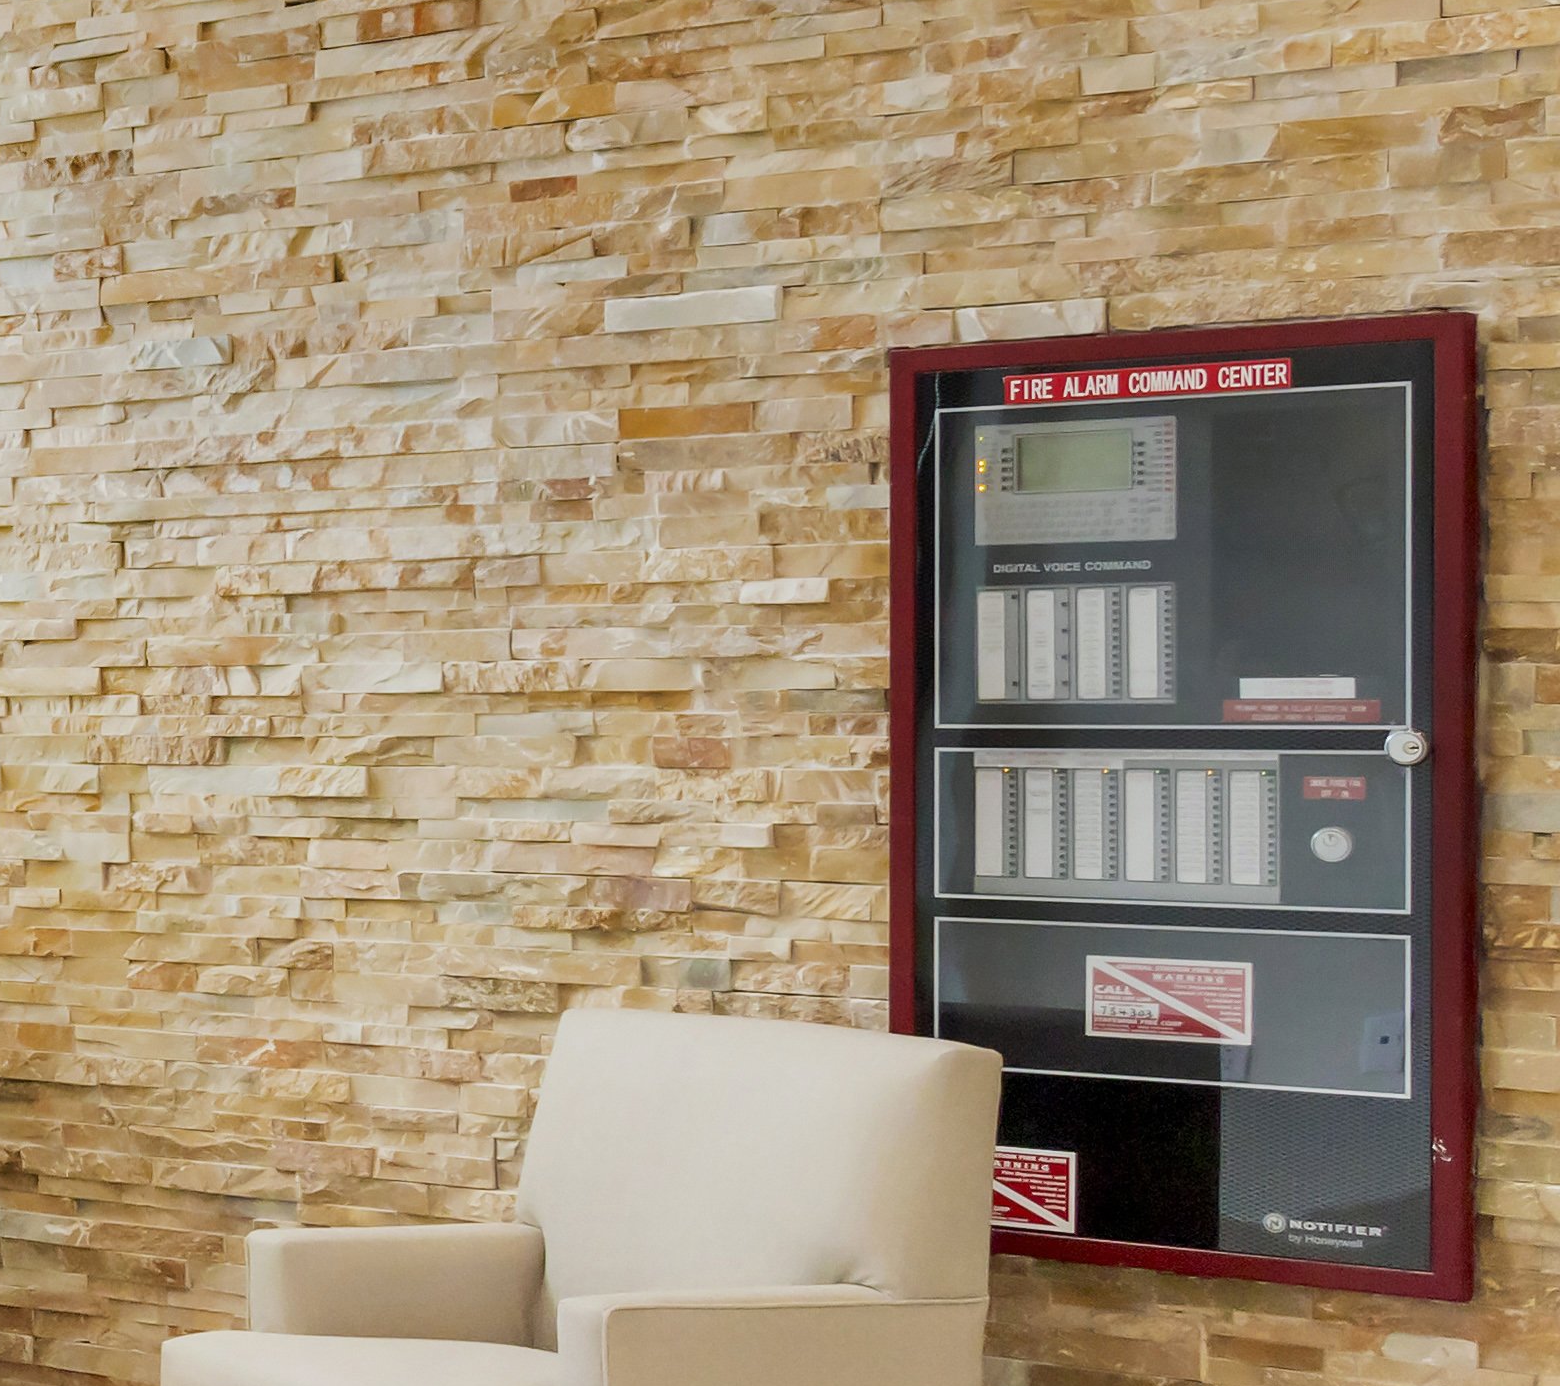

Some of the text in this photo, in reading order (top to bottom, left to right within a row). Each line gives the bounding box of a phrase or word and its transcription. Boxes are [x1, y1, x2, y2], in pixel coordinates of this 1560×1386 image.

[1010, 363, 1288, 401] FIRE ALARM COMMAND CENTER
[993, 560, 1151, 573] DIGITAL VOICE COMMAND
[1152, 973, 1224, 984] WARNING
[1094, 984, 1132, 995] CALL
[994, 1159, 1050, 1172] ARNING
[1289, 1219, 1382, 1237] NOTIFIER
[1288, 1233, 1363, 1249] by Honeywell
